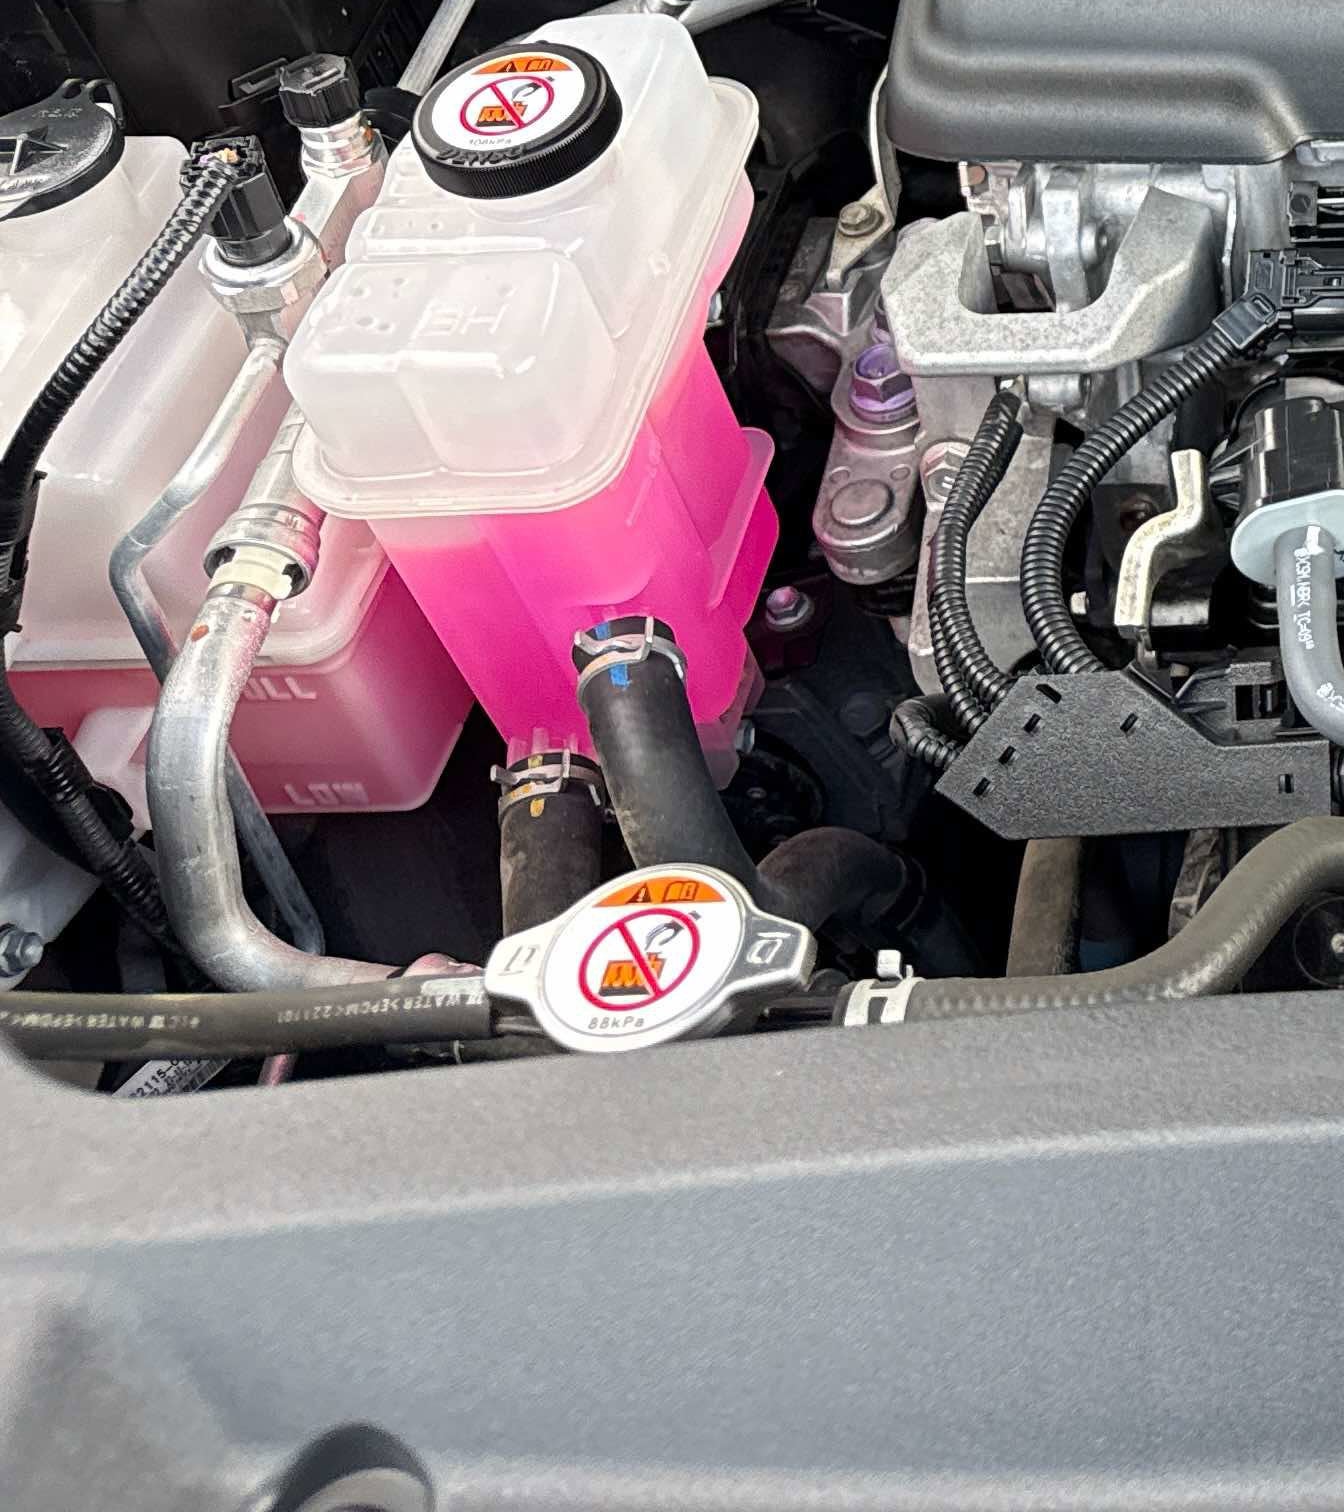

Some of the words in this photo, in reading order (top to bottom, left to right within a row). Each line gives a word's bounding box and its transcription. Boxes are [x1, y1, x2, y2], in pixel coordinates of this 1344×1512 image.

[242, 676, 317, 701] ULL
[284, 783, 369, 806] LOW
[588, 1015, 646, 1031] 88kPa
